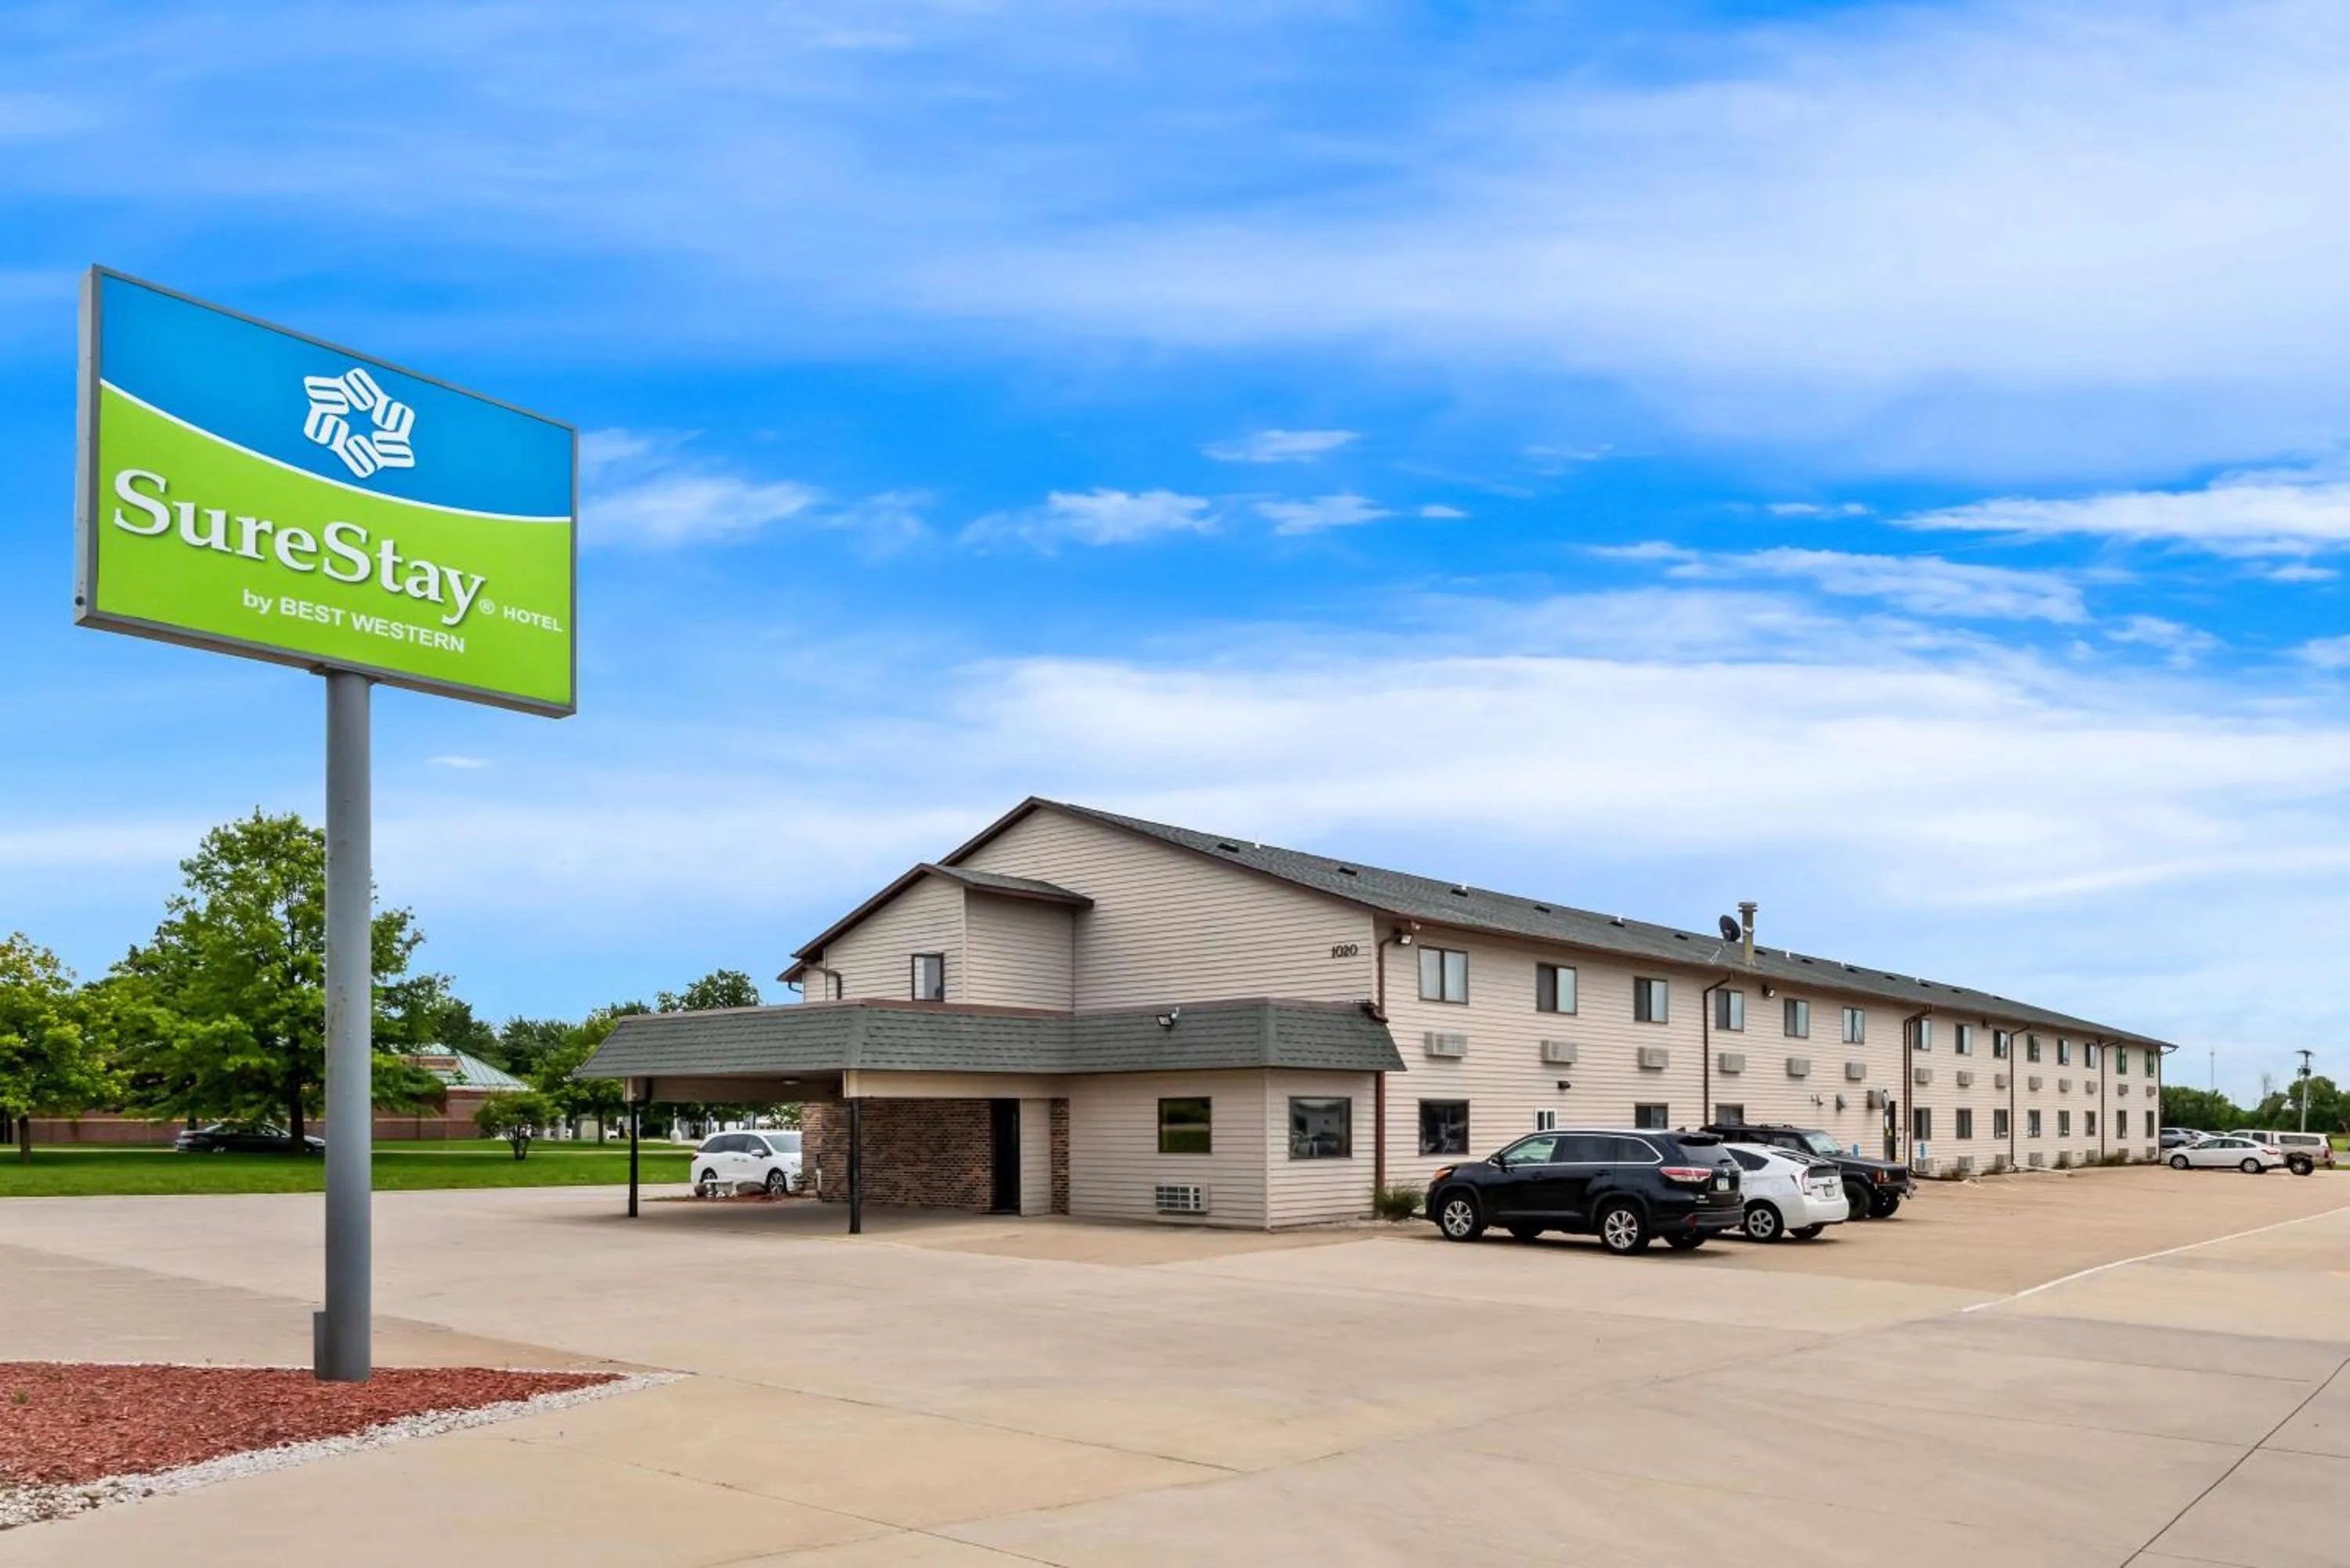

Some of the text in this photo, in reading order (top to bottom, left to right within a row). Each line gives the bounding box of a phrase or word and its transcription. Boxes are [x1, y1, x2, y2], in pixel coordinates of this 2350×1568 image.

[243, 588, 465, 653] by BEST WESTERN
[503, 605, 563, 633] HOTEL
[1332, 944, 1358, 959] 1020
